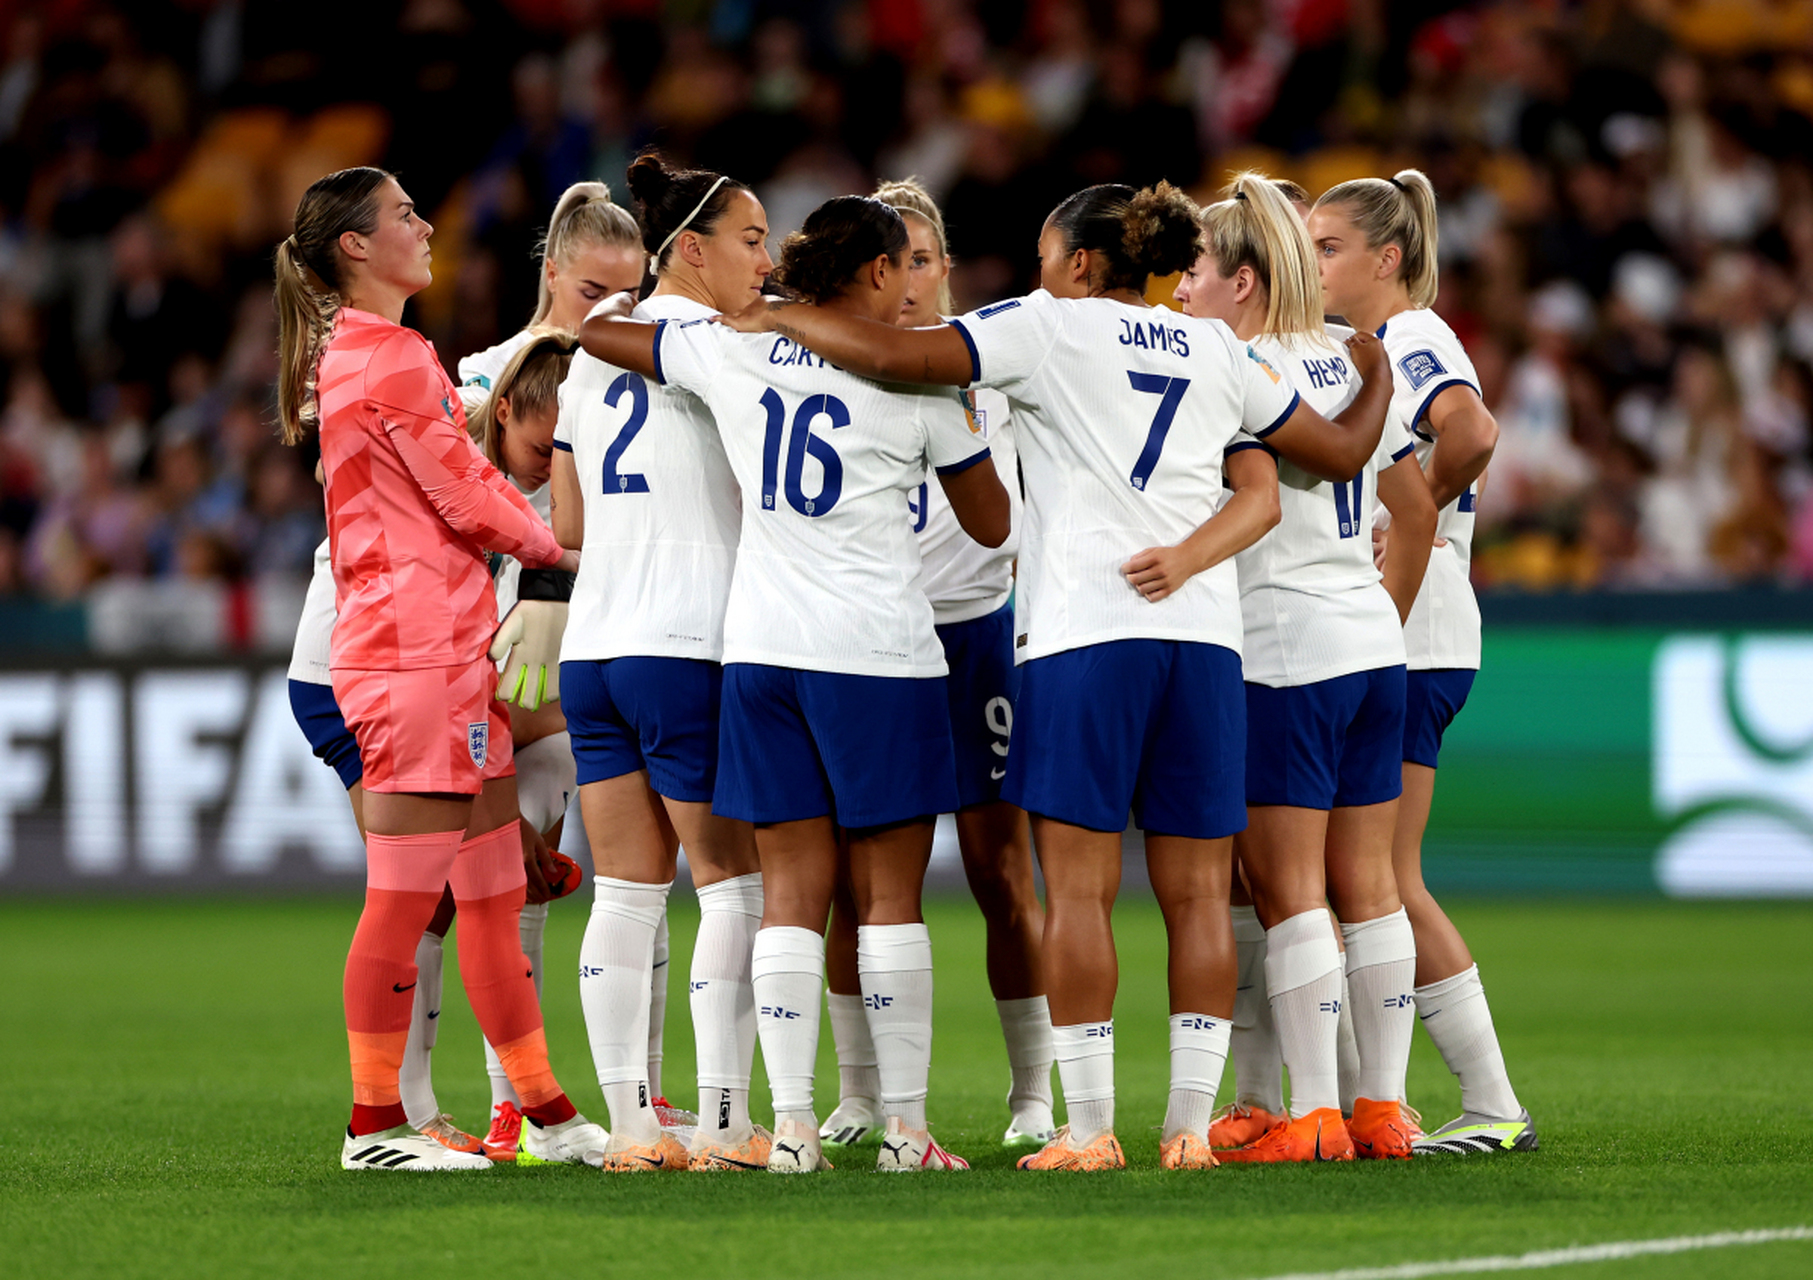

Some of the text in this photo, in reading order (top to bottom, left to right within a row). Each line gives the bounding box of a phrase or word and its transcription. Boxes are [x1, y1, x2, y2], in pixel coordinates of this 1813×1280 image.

[602, 372, 650, 495] 2
[1126, 370, 1191, 492] 7
[1302, 356, 1348, 389] HEMP
[758, 386, 852, 518] 16
[985, 696, 1013, 757] 9
